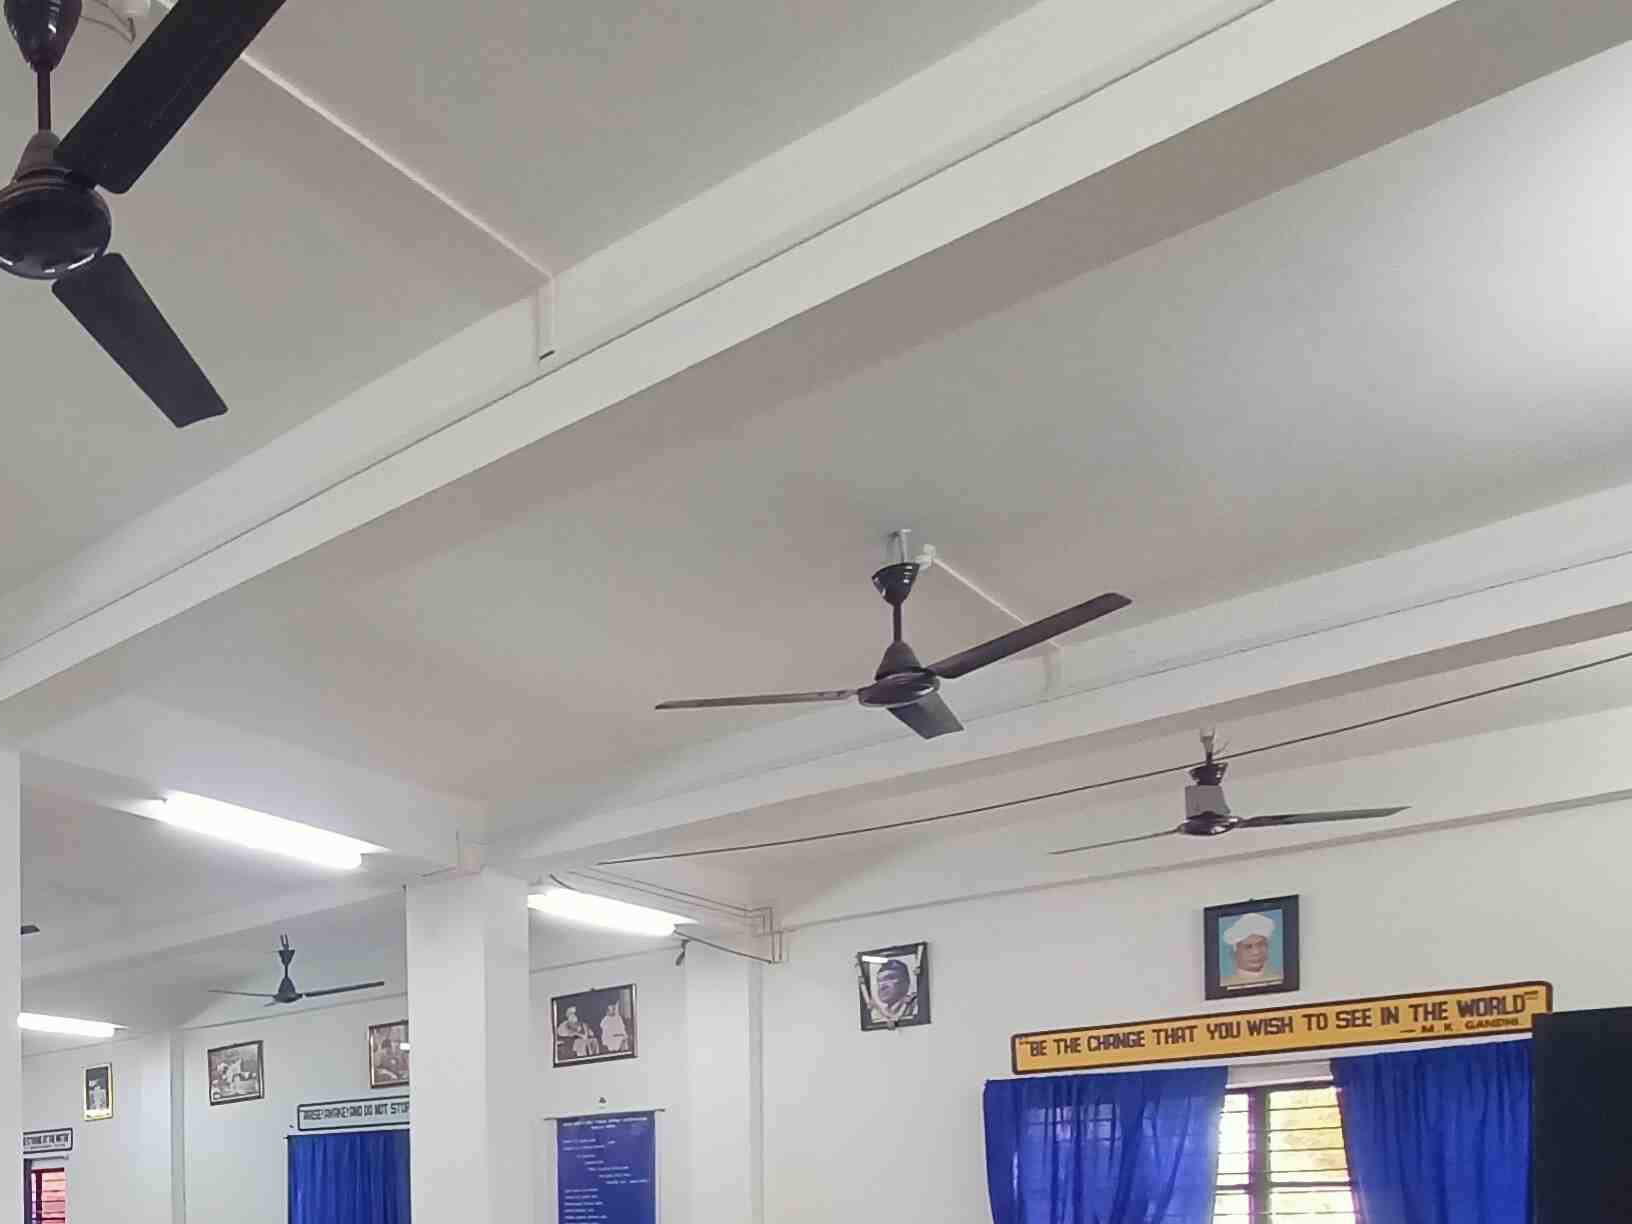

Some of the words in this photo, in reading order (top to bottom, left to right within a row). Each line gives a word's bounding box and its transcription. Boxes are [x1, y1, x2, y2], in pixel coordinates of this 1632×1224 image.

[1053, 1038, 1082, 1056] THE
[1087, 1031, 1146, 1052] CHANGE
[1152, 1026, 1198, 1046] THAT
[1206, 1021, 1241, 1041] YOU
[1247, 1016, 1293, 1036] WISH
[1302, 1013, 1329, 1031] TO
[1335, 1008, 1372, 1029] SEE
[1380, 1006, 1400, 1026] IN
[1408, 1001, 1449, 1022] THE
[374, 1103, 388, 1115] NOT
